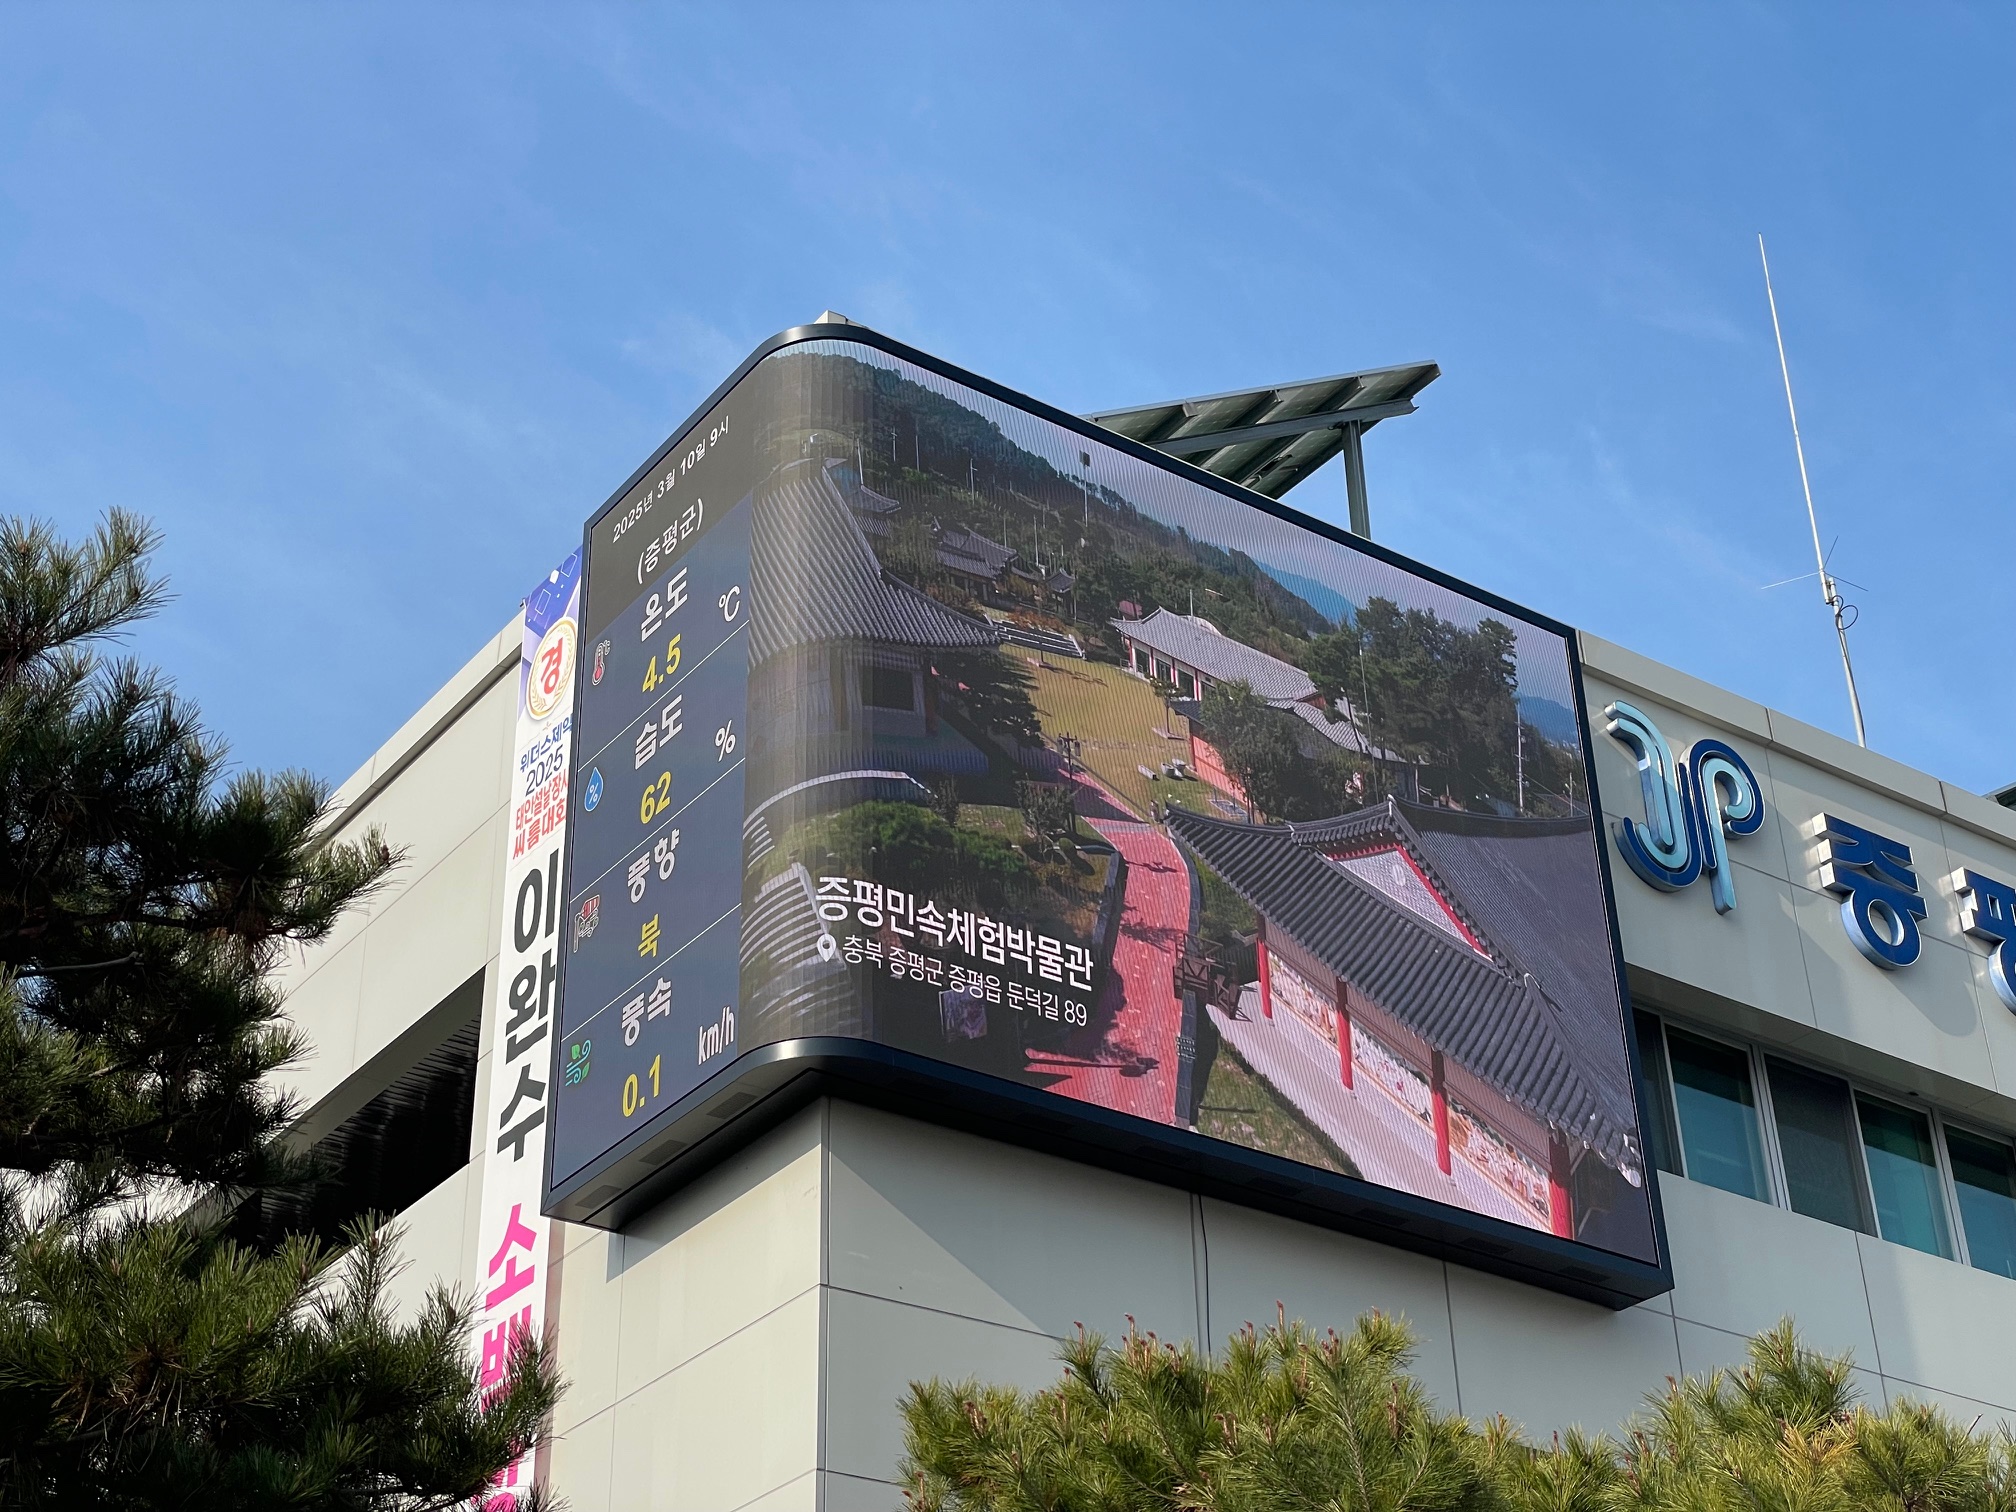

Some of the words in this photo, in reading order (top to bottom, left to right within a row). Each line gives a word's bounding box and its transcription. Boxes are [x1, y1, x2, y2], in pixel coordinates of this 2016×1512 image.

[612, 490, 653, 543] 2025년
[657, 468, 676, 499] 3월
[680, 438, 706, 476] 10일
[710, 415, 729, 447] 9시
[637, 498, 703, 585] (증평군)
[640, 566, 688, 642] 온도
[541, 637, 564, 694] 경
[642, 633, 681, 693] 4.5
[634, 694, 683, 770] 습도
[714, 719, 737, 762] %
[525, 744, 563, 797] 2025
[640, 771, 672, 825] 62
[627, 828, 681, 904] 풍향
[637, 913, 662, 958] 북
[815, 876, 1094, 992] 증평민속체험박물관
[497, 848, 559, 1163] 이완수
[621, 976, 672, 1047] 풍속
[842, 934, 884, 969] 충북
[888, 945, 944, 987] 증평군
[949, 963, 1003, 1005] 증평읍
[1006, 982, 1060, 1022] 둔덕길
[1064, 1000, 1088, 1027] 89
[698, 1006, 735, 1067] km/h
[621, 1054, 661, 1118] 0.1
